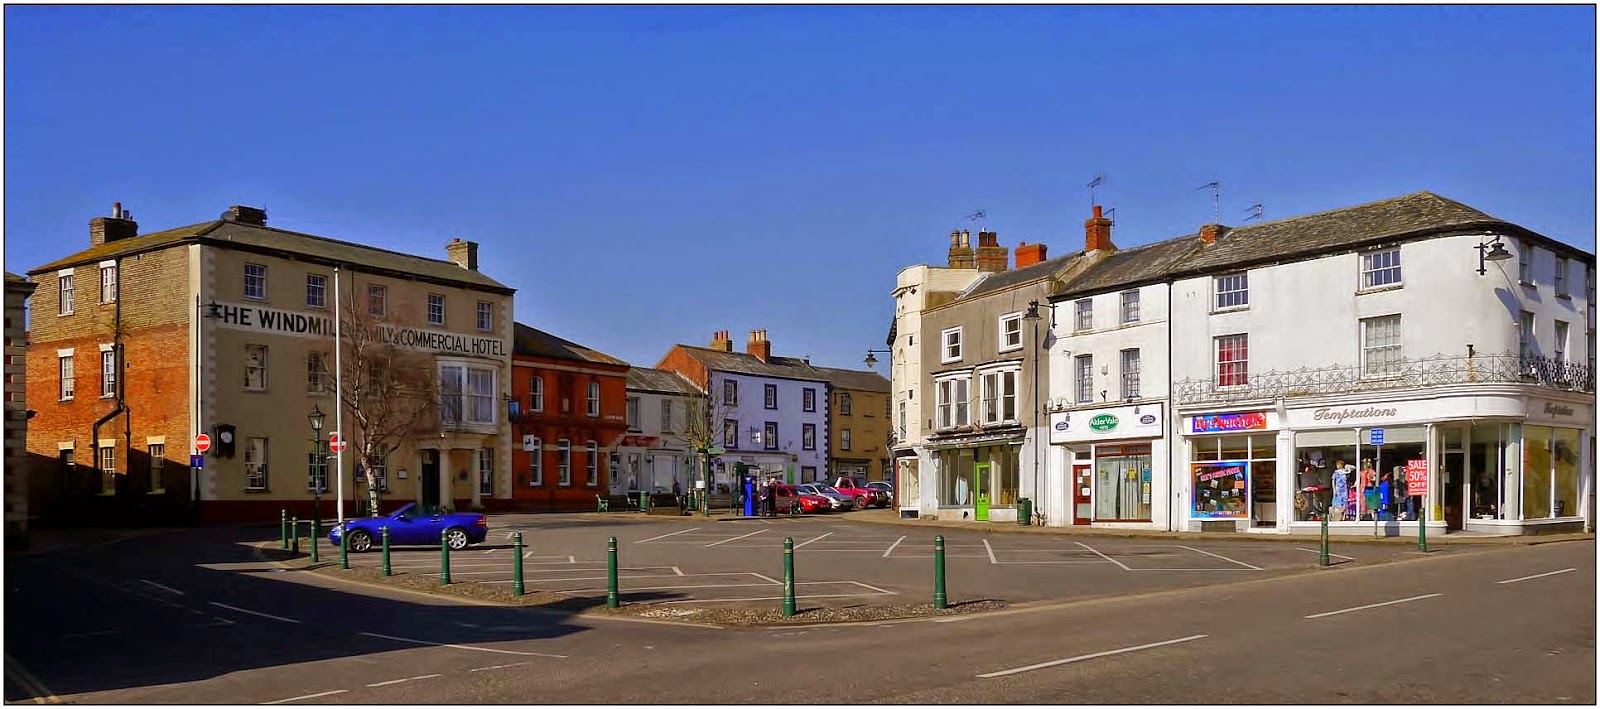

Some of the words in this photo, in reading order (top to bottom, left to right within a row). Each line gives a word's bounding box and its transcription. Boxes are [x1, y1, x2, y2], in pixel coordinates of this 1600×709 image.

[211, 303, 252, 326] THE
[400, 329, 470, 353] COMMERCIAL
[472, 338, 507, 356] HOTEL
[1314, 407, 1397, 424] Temptations
[1408, 460, 1427, 470] SALE
[1409, 470, 1427, 481] 50%
[1409, 481, 1427, 489] OFF
